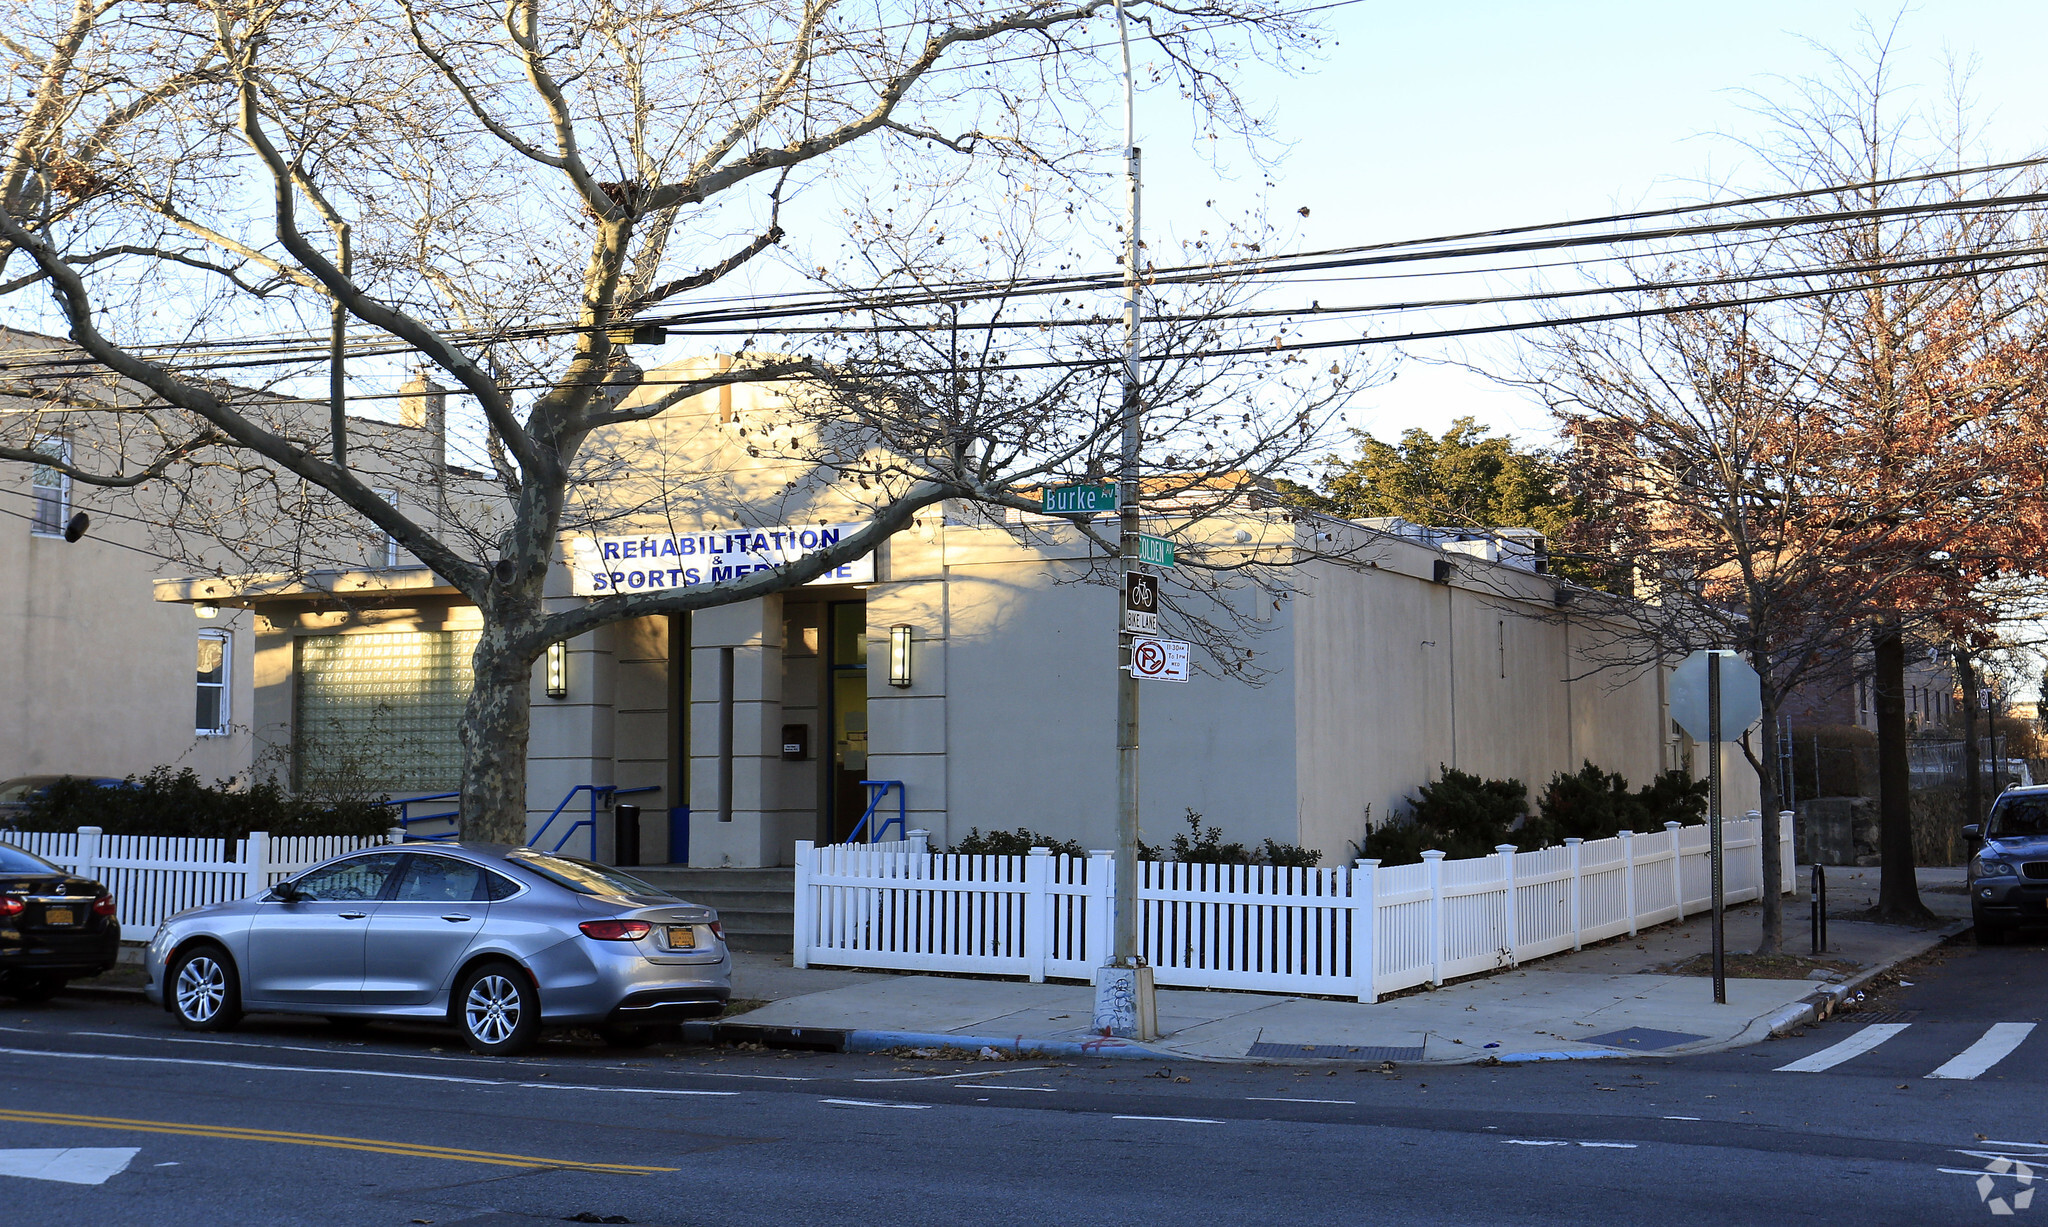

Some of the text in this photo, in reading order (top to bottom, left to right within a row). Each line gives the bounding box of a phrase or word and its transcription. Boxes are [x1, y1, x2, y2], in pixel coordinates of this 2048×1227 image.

[1046, 487, 1096, 510] Burke
[603, 528, 840, 560] REHABILITATION
[712, 555, 723, 565] &
[593, 567, 701, 591] SPORTS
[1128, 612, 1156, 630] BIKE LANE
